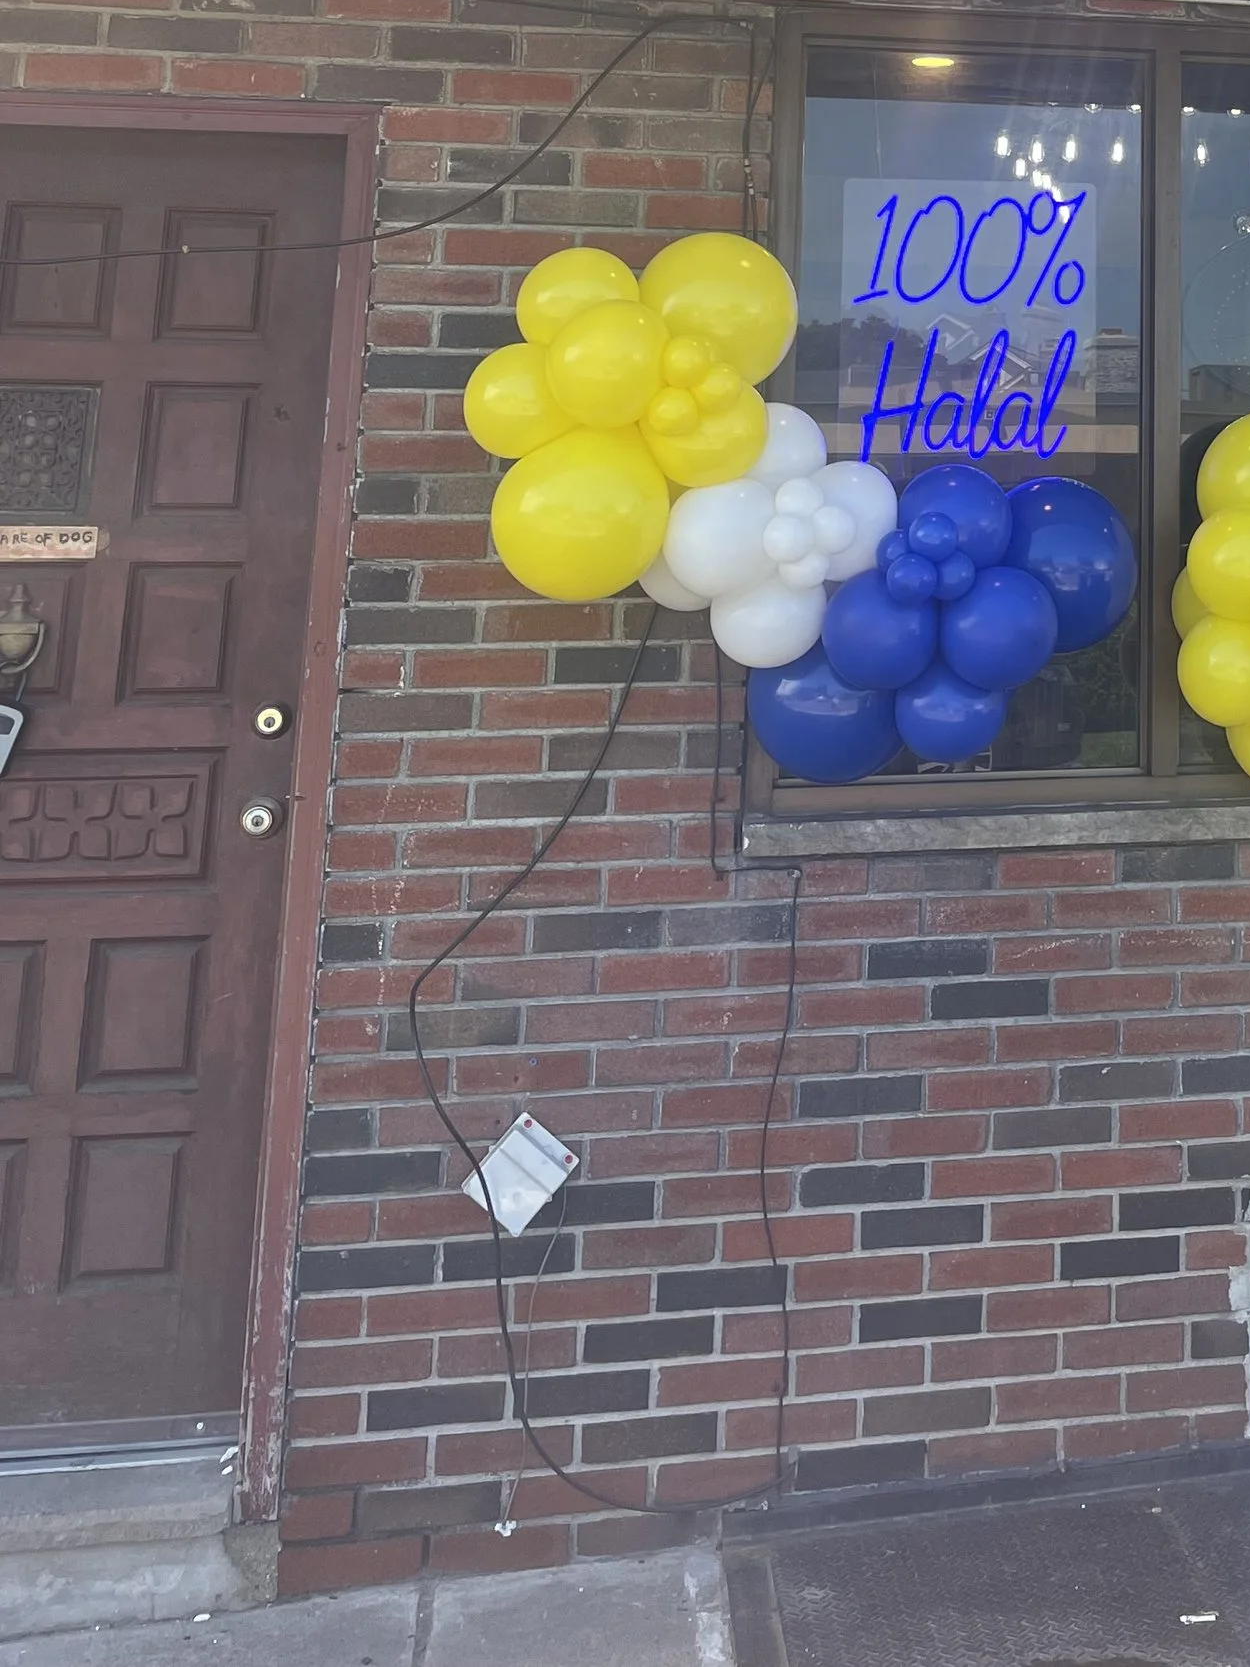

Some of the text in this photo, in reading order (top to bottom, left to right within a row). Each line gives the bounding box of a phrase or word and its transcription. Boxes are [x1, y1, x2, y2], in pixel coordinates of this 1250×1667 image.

[852, 190, 1088, 308] 100%
[858, 327, 1077, 466] Halal
[35, 533, 53, 547] OF
[59, 531, 93, 544] DOG
